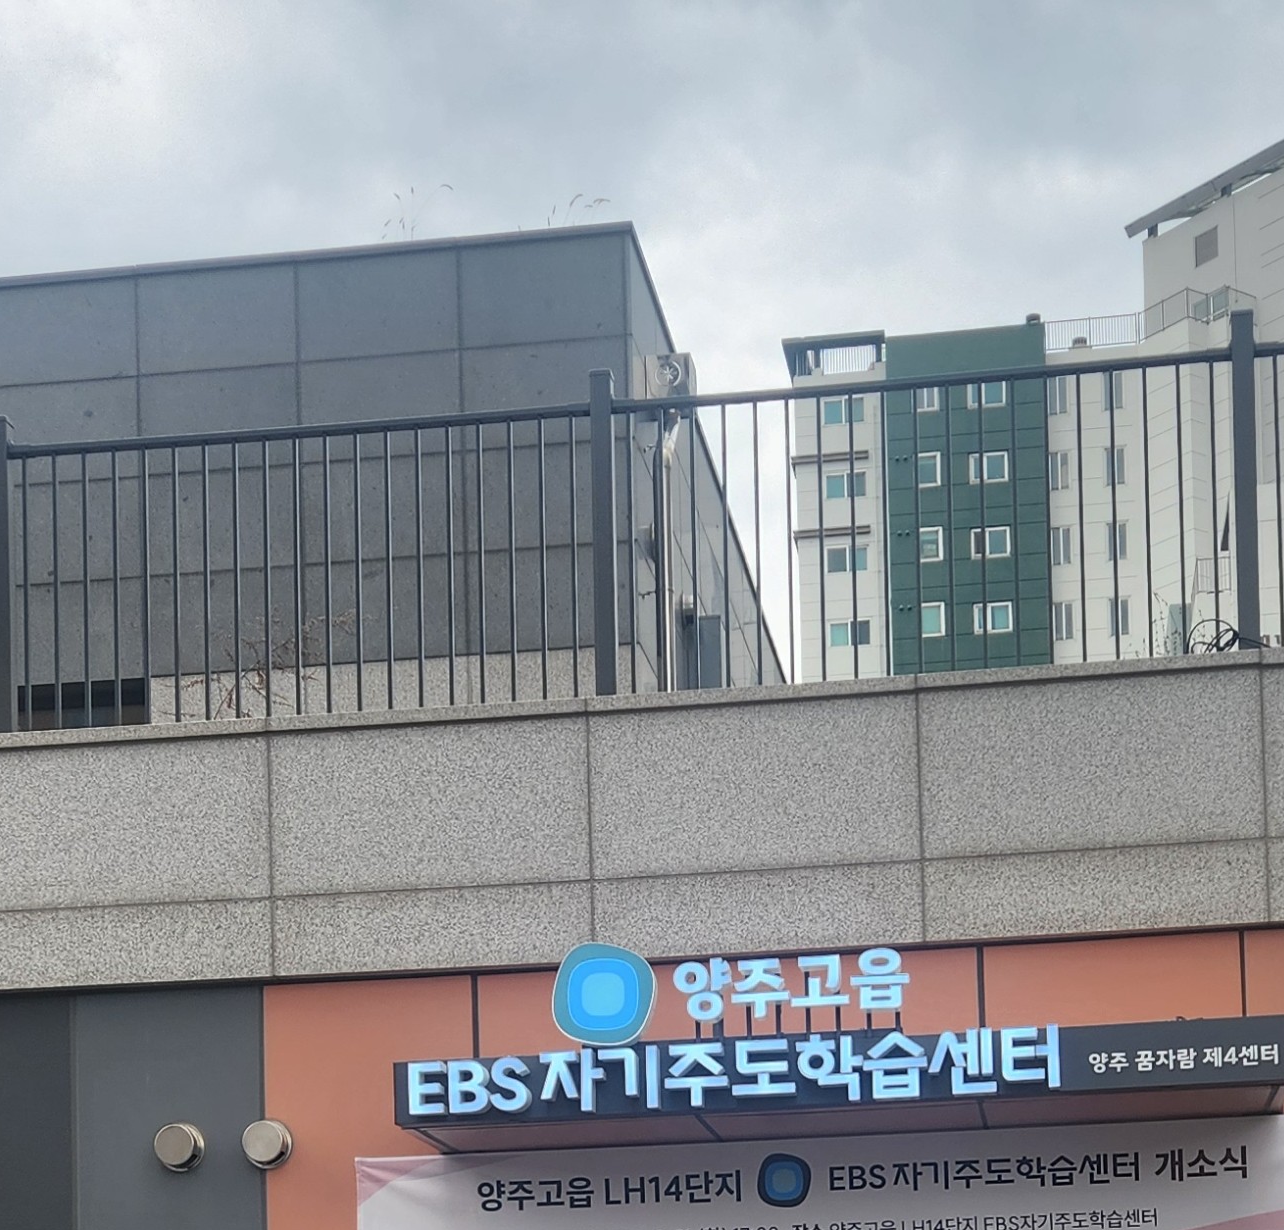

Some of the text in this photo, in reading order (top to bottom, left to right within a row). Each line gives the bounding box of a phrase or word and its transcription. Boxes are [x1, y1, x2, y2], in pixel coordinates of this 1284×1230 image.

[673, 947, 910, 1024] 양주고읍
[407, 1023, 1062, 1117] EBS 자기주도학습센터
[1088, 1043, 1280, 1074] 양주 꿈자람 제4센터
[477, 1169, 742, 1212] 양주고읍 LH14단지
[829, 1145, 1248, 1191] EBS 자기주도학습센터 개소식
